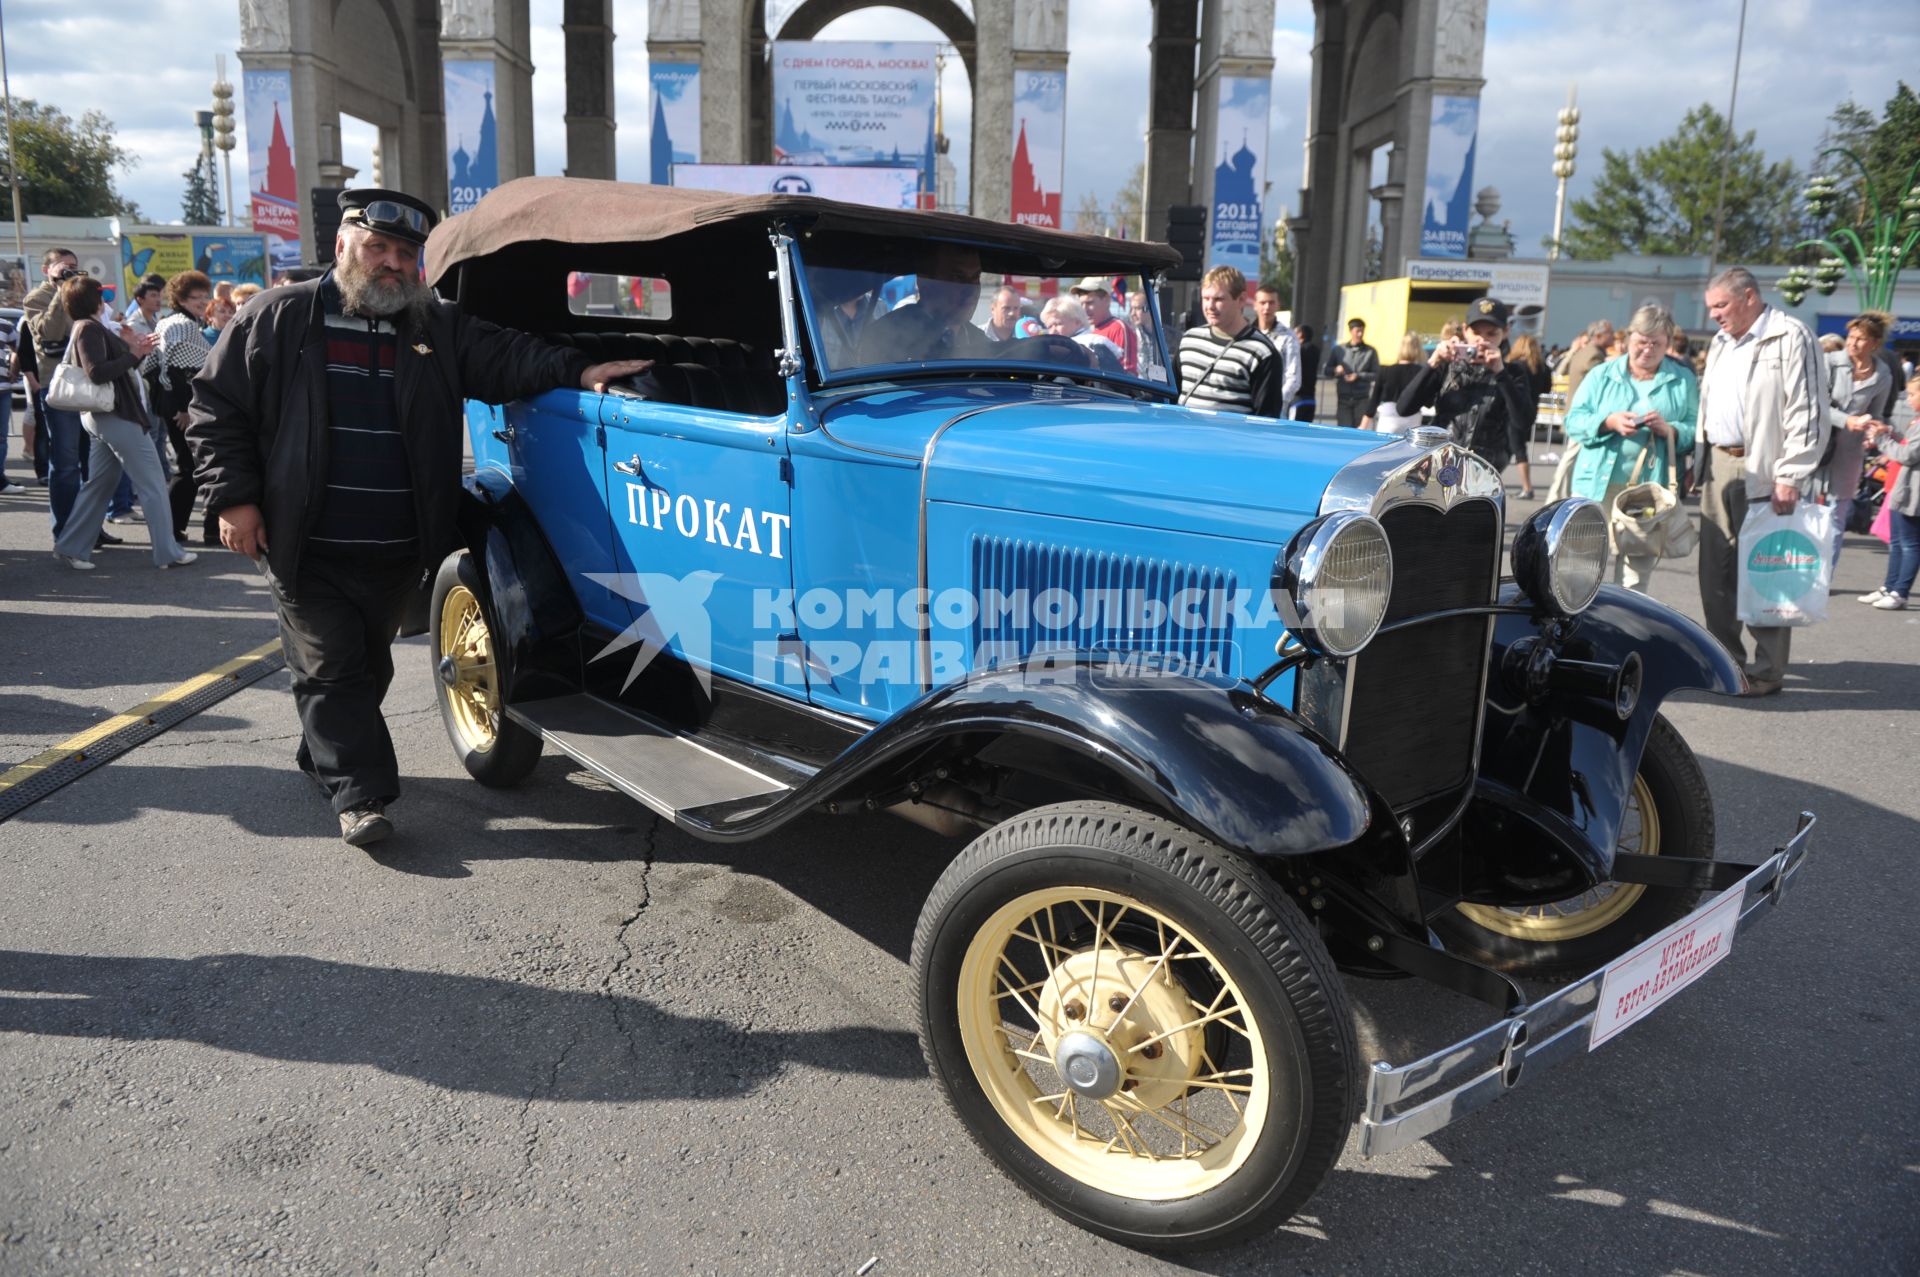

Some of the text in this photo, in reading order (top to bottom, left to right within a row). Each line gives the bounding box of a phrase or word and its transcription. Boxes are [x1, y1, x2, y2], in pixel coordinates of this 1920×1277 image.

[783, 58, 791, 67] С
[793, 59, 824, 69] ДНЕМ
[878, 60, 929, 70] МОСКВА!
[248, 75, 287, 91] 1925
[794, 77, 918, 92] ПЕРВЫЙ МОСКОВСКИЙ
[805, 93, 907, 106] ФЕСТИВАЛЬ ТАКСИ
[258, 205, 292, 218] ВЧЕРА
[1217, 203, 1259, 220] 2011
[1016, 212, 1054, 225] ВЧЕРА
[1215, 220, 1259, 231] СЕГОДНЯ
[1424, 230, 1466, 242] ЗАВТРА
[1411, 264, 1493, 280] Перекресток
[625, 482, 790, 559] ПРОКАТ
